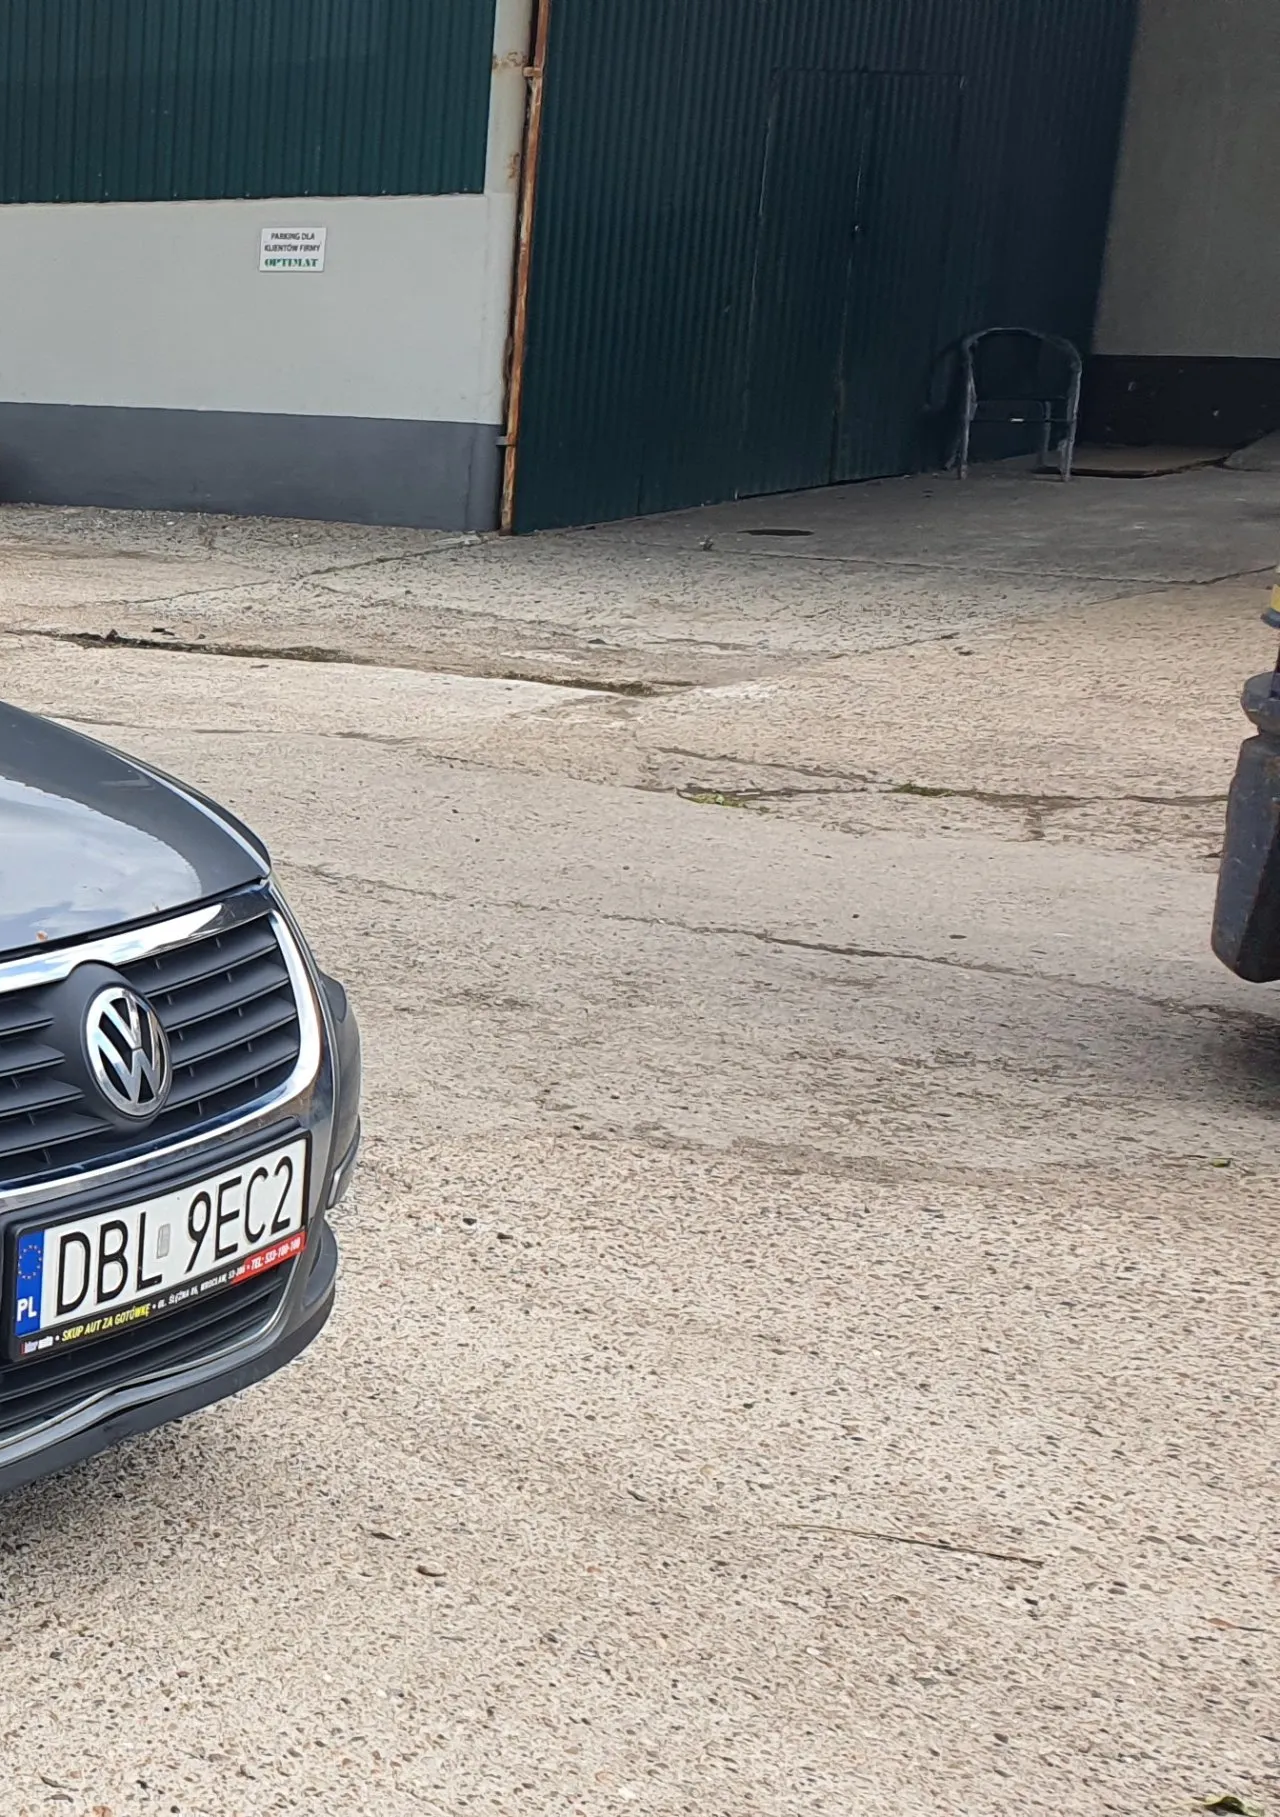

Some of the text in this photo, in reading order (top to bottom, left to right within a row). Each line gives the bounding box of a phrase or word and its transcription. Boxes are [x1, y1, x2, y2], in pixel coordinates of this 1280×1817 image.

[301, 232, 315, 240] DLA
[264, 258, 319, 268] OPTIMAT
[54, 1155, 293, 1317] DBL 9EC2
[16, 1296, 37, 1322] PL
[62, 1325, 85, 1342] SKUP
[84, 1320, 102, 1335] AUT
[101, 1317, 113, 1330] ZA
[114, 1303, 151, 1324] GOTÓWKĘ
